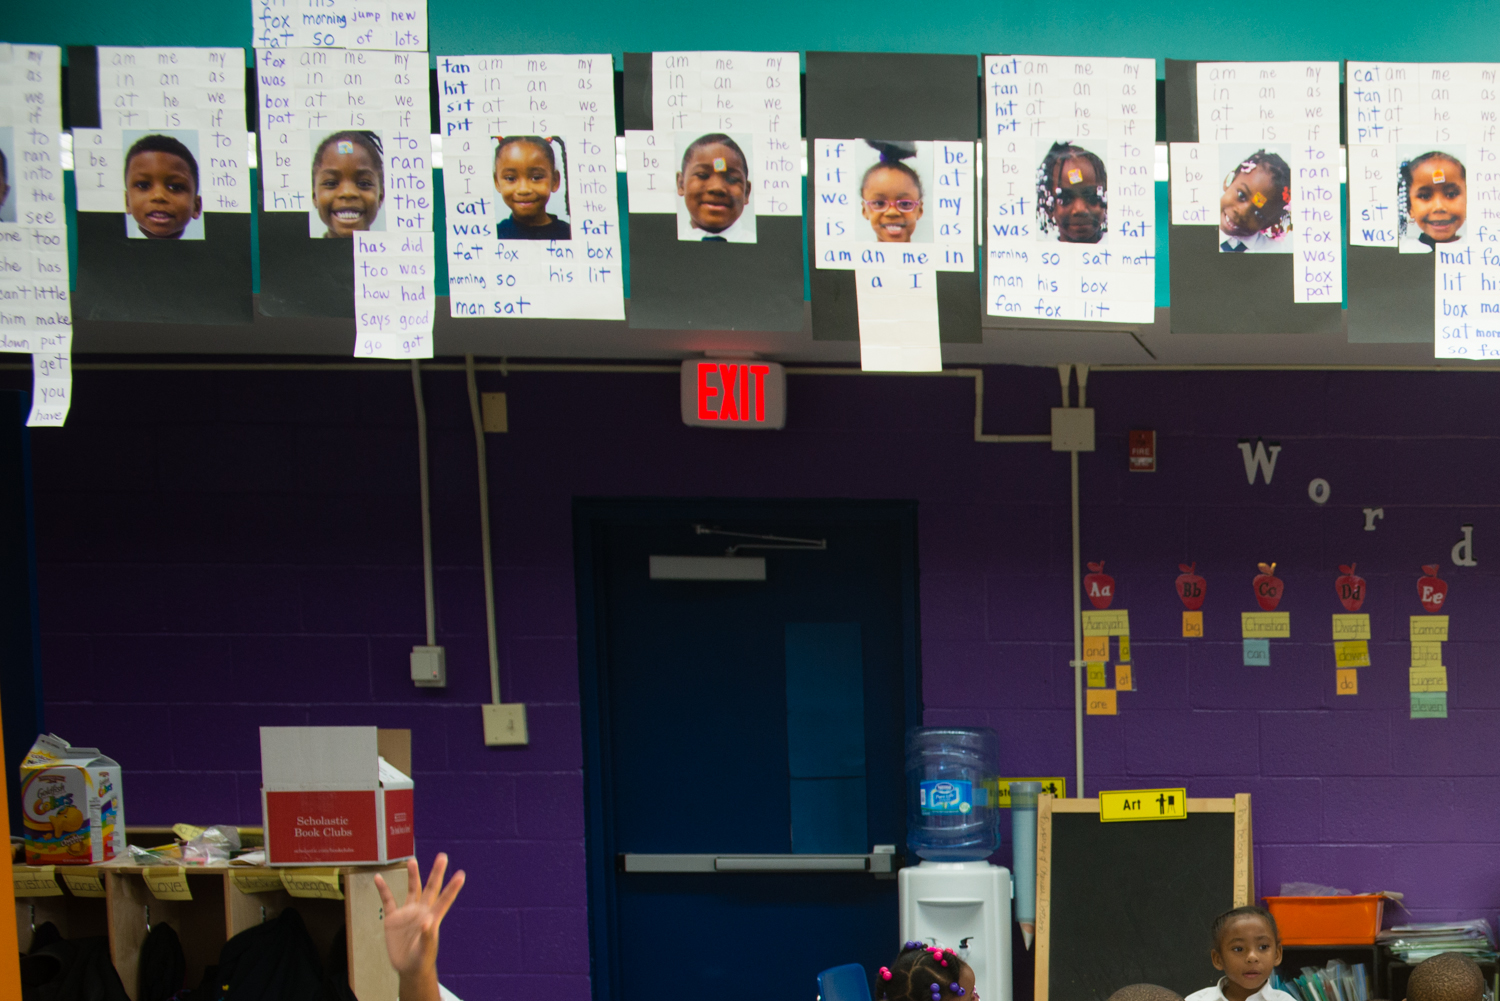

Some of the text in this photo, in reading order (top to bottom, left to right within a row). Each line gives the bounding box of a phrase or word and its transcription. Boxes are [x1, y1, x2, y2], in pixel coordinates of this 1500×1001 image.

[259, 7, 416, 29] fox morning jump new
[258, 28, 419, 48] fat so of lots
[261, 52, 286, 69] fox
[441, 61, 471, 74] tan
[989, 59, 1021, 76] cat
[443, 81, 468, 96] hit
[991, 82, 1018, 96] tan
[264, 94, 290, 109] box
[995, 101, 1018, 117] hit
[447, 118, 473, 136] pit
[943, 146, 968, 165] be
[273, 192, 305, 210] hit
[456, 199, 491, 215] cat
[821, 192, 848, 206] we
[939, 196, 962, 215] my
[999, 199, 1030, 216] sit
[452, 220, 614, 236] was fat
[993, 220, 1152, 238] was fat
[452, 241, 613, 261] fat fox fan box
[824, 245, 964, 265] am an me in
[1440, 248, 1472, 266] mat
[449, 266, 611, 289] morning so his lit
[455, 297, 531, 316] man sat
[697, 362, 770, 422] EXIT
[1090, 582, 1111, 597] Aa
[1182, 583, 1201, 598] Bb
[1342, 583, 1361, 600] Dd
[1422, 586, 1443, 604] Ee
[1185, 620, 1201, 635] big
[1245, 617, 1288, 632] Christian
[1334, 619, 1367, 639] Dwight
[1086, 645, 1106, 657] and
[1246, 649, 1266, 659] can
[1340, 677, 1354, 690] do
[1090, 700, 1107, 710] are
[1411, 697, 1444, 712] eleven
[1123, 799, 1141, 811] Art
[296, 815, 349, 826] Scholastic
[294, 827, 353, 837] Book Clubs
[150, 876, 183, 893] Love
